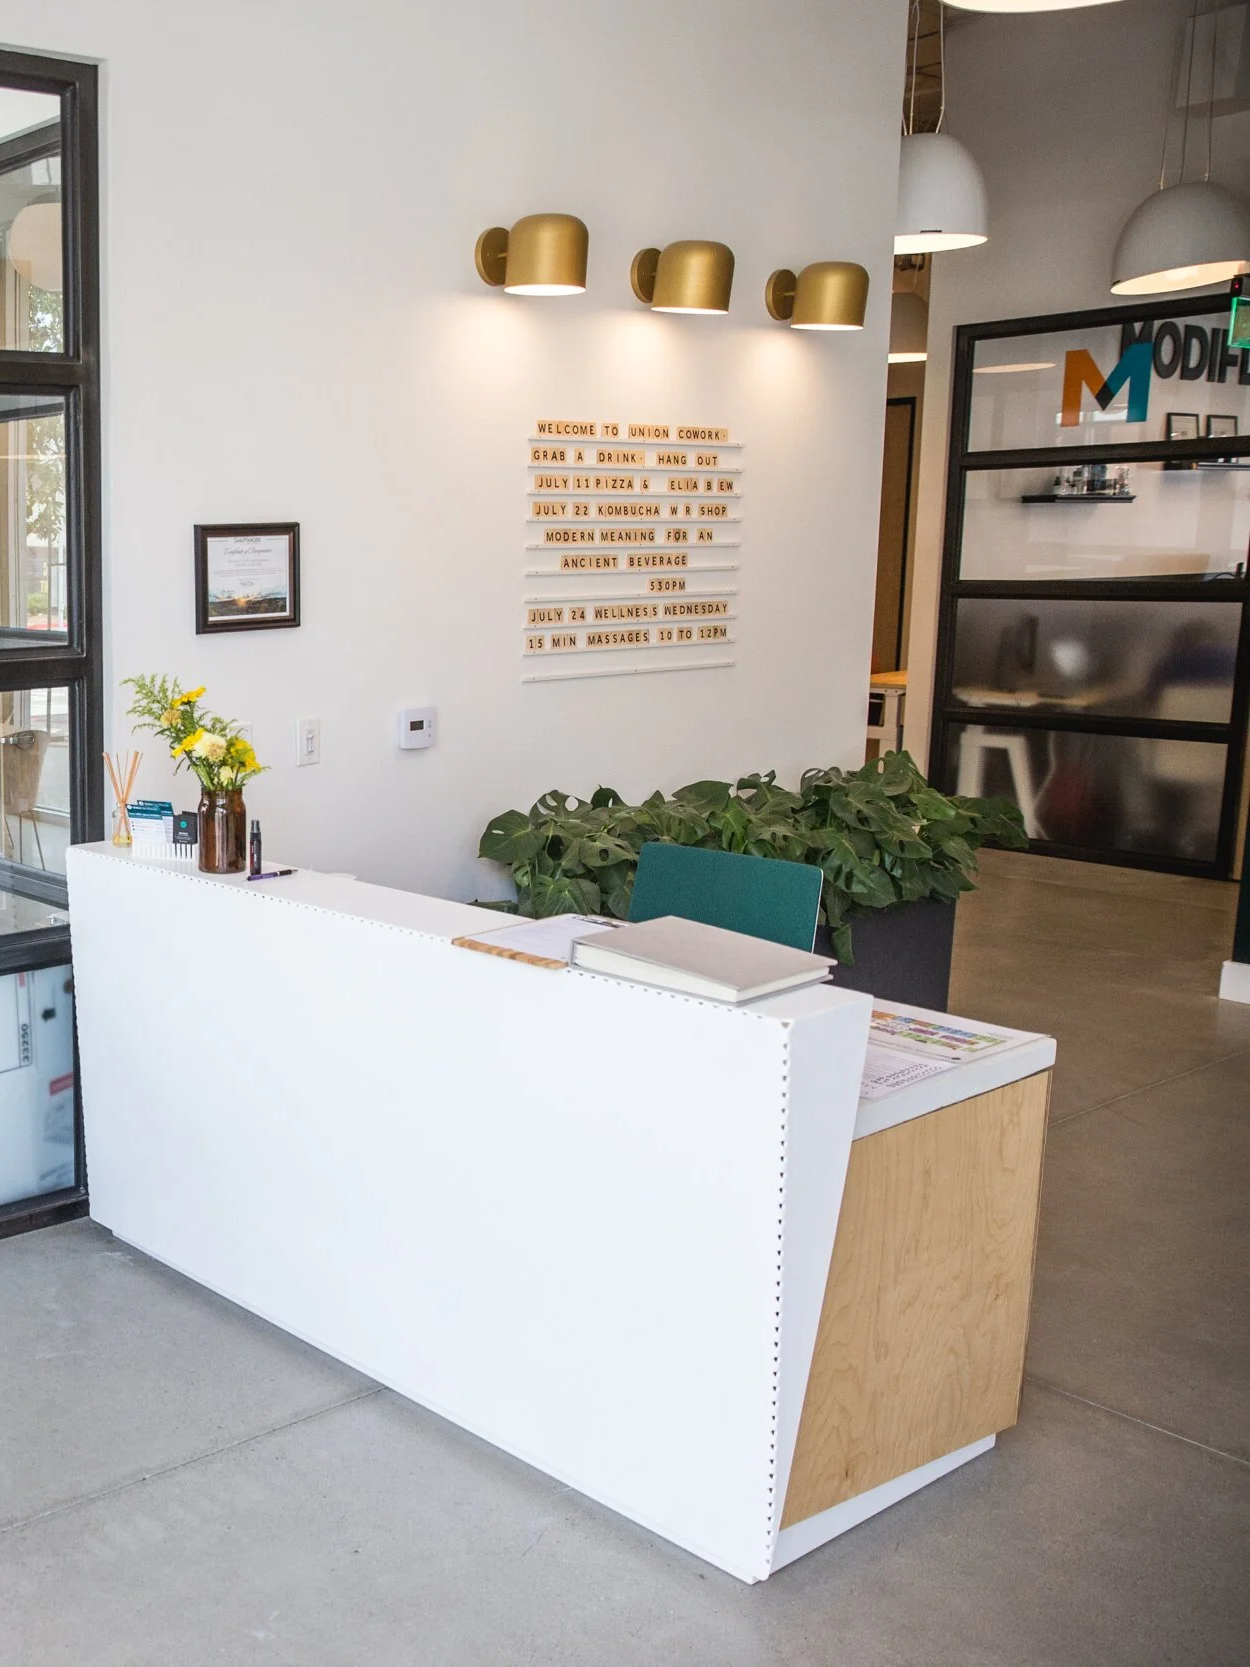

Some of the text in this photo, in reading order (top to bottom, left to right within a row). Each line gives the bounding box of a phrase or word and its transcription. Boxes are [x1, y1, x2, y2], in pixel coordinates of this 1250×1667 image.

[1061, 342, 1154, 427] M
[538, 423, 595, 434] WELCOME
[604, 425, 619, 436] TO
[630, 427, 669, 438] UNION
[533, 450, 565, 461] GRAB
[577, 451, 584, 461] A
[658, 454, 687, 465] HANG
[697, 456, 718, 465] OUT
[538, 477, 568, 488] JULY
[576, 478, 589, 488] 11
[595, 478, 633, 489] PIZZA
[642, 479, 649, 489] &
[670, 480, 698, 490] ELIA
[536, 505, 566, 515] JULY
[575, 506, 588, 516] 22
[598, 506, 660, 516] KOMBUCHA
[701, 506, 727, 516] SHOP
[546, 532, 594, 542] MODERN
[600, 532, 655, 541] MEANING
[698, 532, 713, 541] AN
[563, 555, 687, 568] ANCIENT BEVERAGE
[531, 603, 728, 622] JULY 24 WELLNESS WEDNESDAY
[529, 627, 727, 649] 15 MIN MASSAGES 10 TO 12PM
